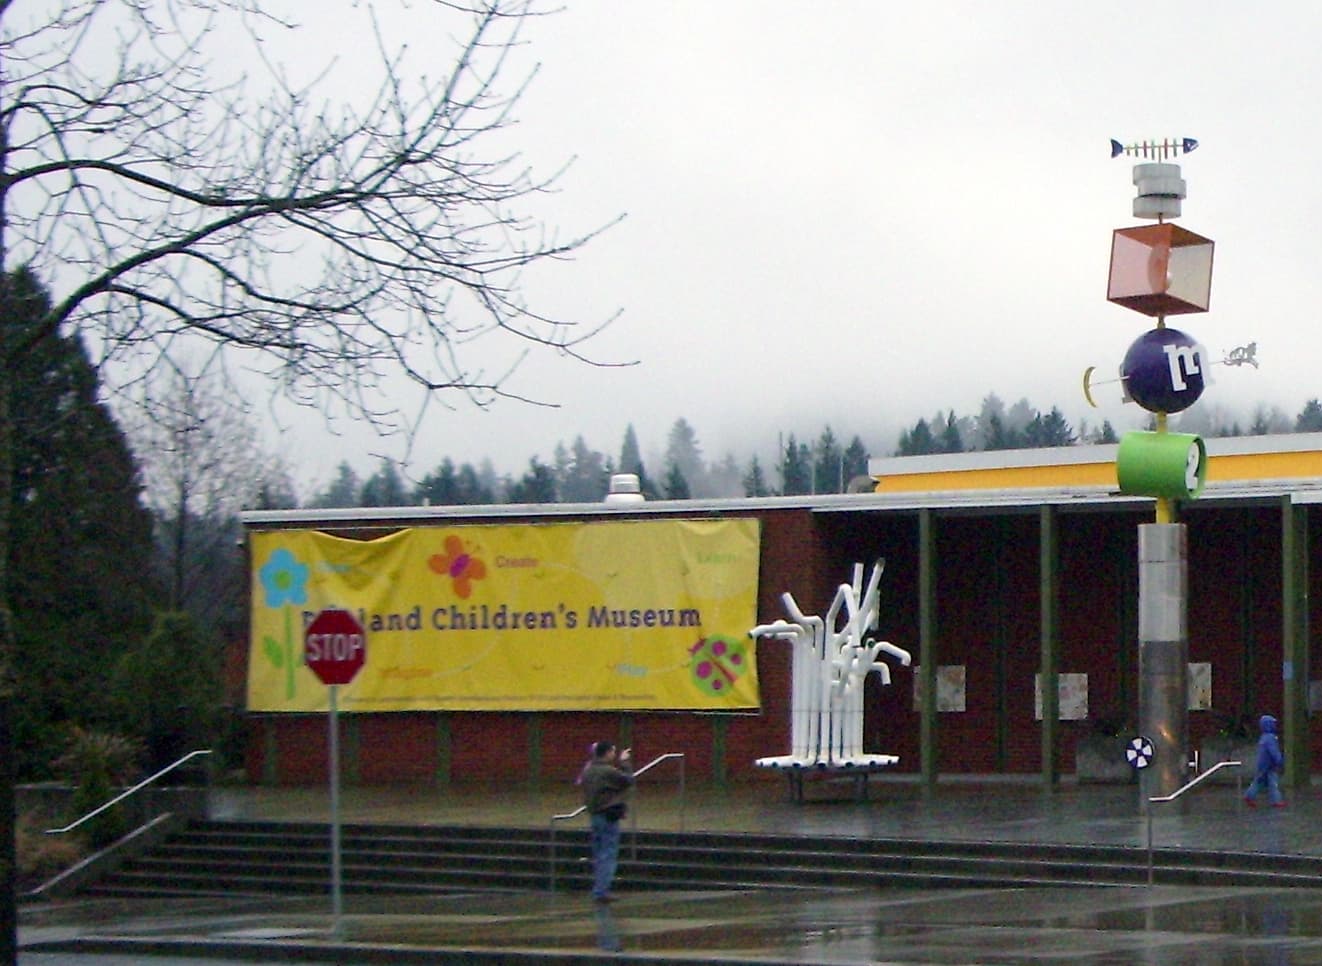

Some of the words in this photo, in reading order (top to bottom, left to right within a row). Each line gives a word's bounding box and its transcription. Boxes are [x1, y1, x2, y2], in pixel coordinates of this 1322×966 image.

[431, 603, 578, 630] Children's
[587, 606, 703, 628] Museum
[307, 633, 363, 662] STOP
